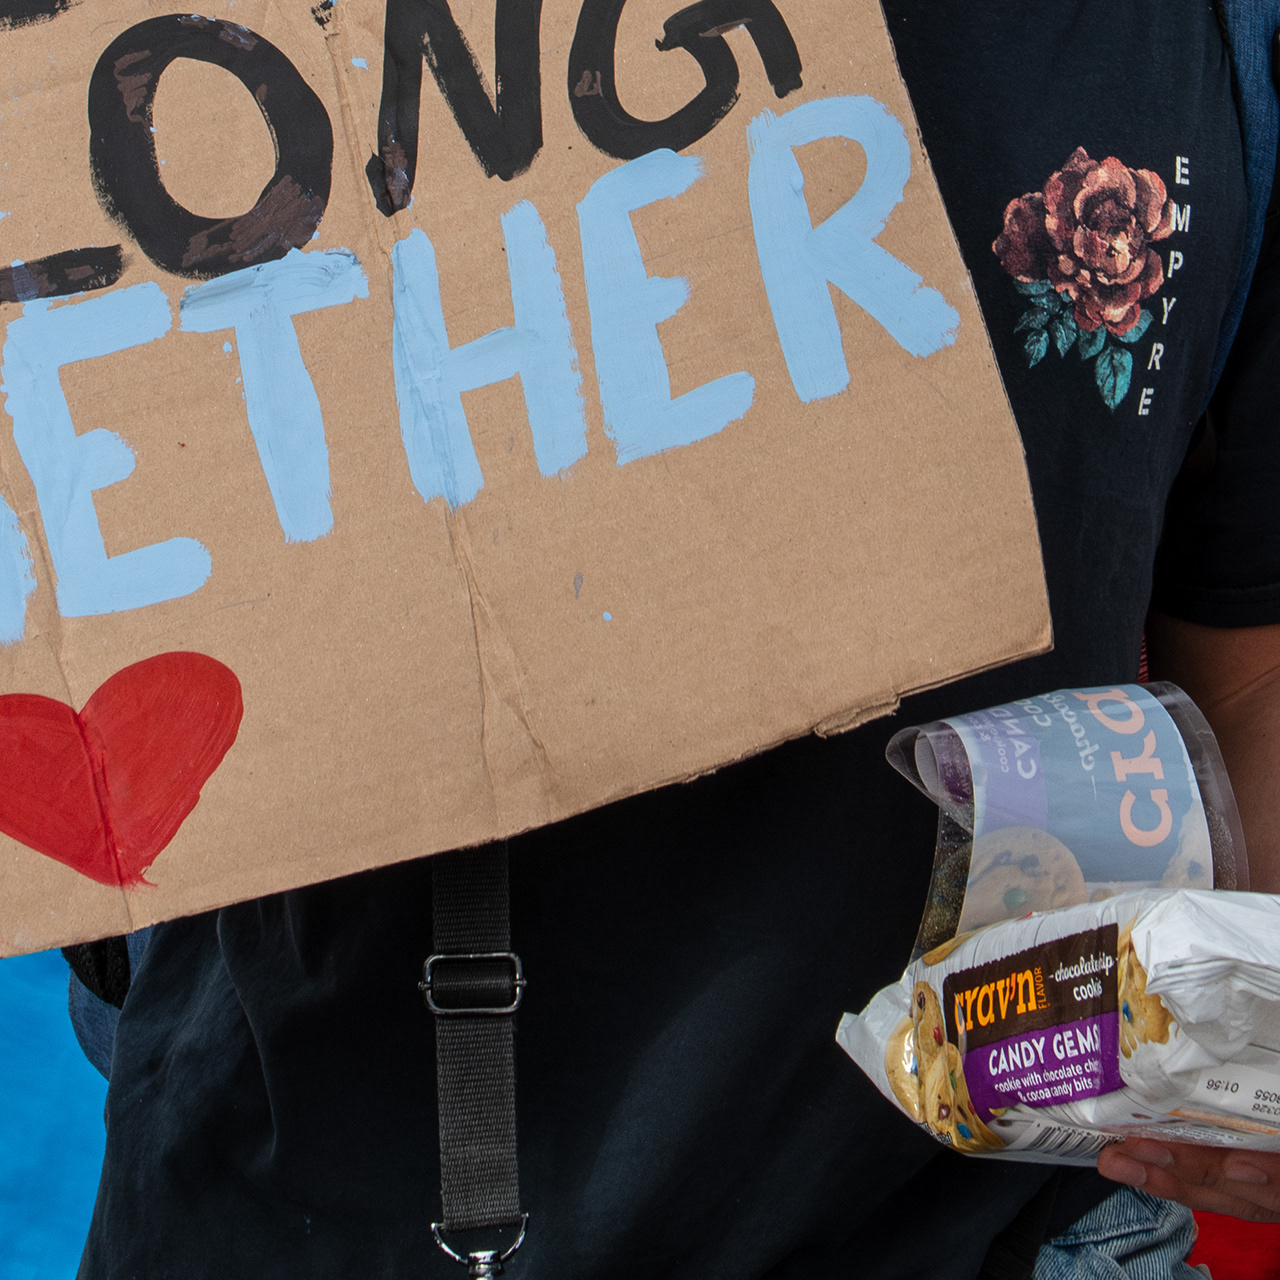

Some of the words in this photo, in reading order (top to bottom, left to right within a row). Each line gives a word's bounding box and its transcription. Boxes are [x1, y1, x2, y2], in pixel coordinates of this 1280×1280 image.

[1137, 155, 1191, 416] EMPYRE
[1034, 966, 1049, 1010] FLAVOR
[988, 1036, 1046, 1077] CANDY
[1053, 1023, 1100, 1061] GEMS
[1021, 1071, 1043, 1088] with
[1043, 1063, 1084, 1083] chocolate
[1026, 1086, 1052, 1103] cocoa
[1051, 1080, 1073, 1098] candy
[1073, 1076, 1094, 1092] bits
[1206, 1079, 1240, 1094] 01:56
